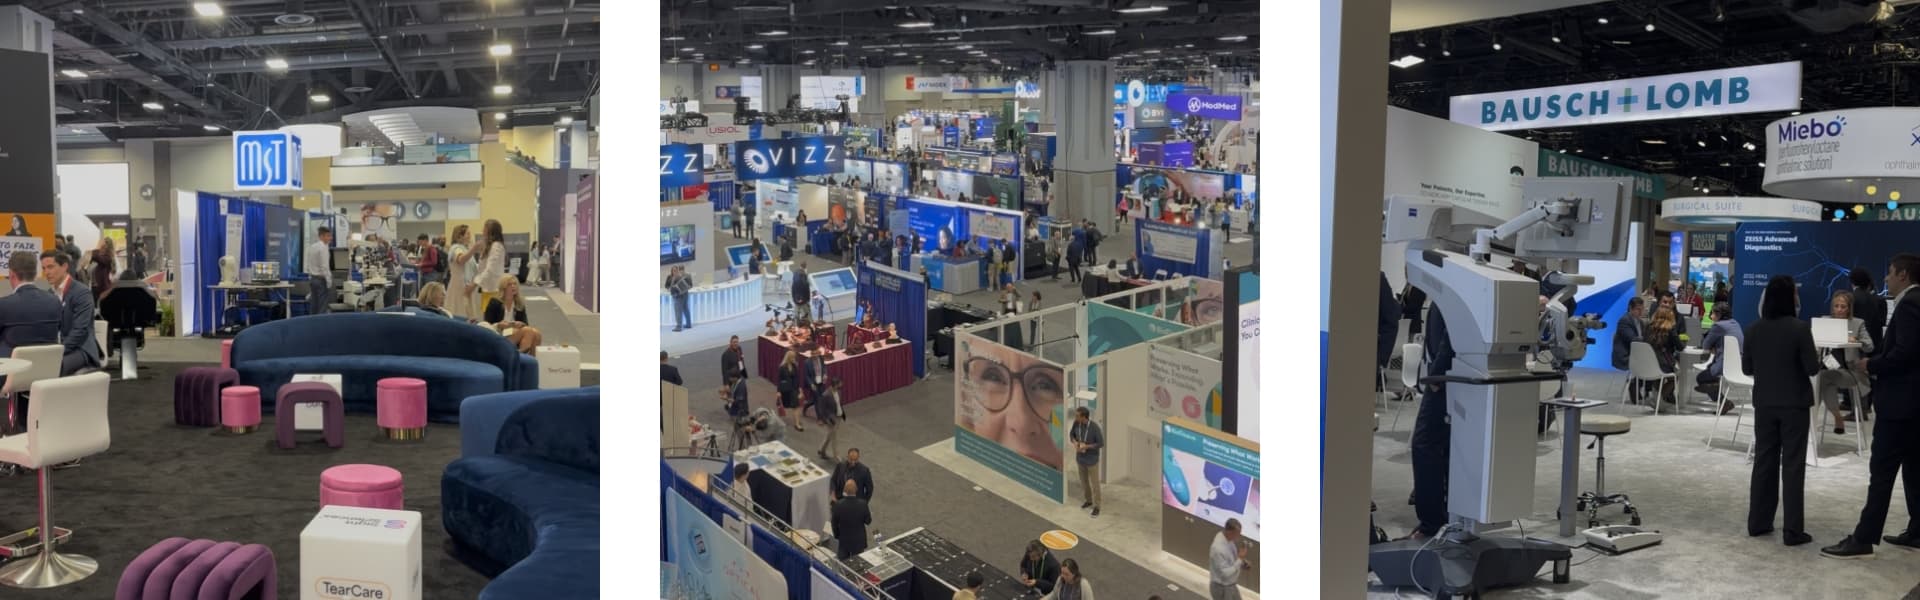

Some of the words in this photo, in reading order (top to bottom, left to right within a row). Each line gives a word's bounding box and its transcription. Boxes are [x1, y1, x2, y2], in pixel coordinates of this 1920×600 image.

[1201, 101, 1237, 111] ModMed
[1481, 90, 1610, 124] BAUSCH
[1617, 87, 1638, 112] +
[1646, 76, 1750, 112] LOMB
[1778, 117, 1843, 144] Miebo
[768, 145, 836, 166] VIZZ
[1673, 200, 1711, 211] SURGICAL
[1715, 201, 1743, 211] SUITE
[1879, 208, 1920, 220] BAU
[14, 241, 35, 250] FAIR
[1744, 244, 1782, 252] Diagnostics
[322, 581, 383, 599] TearCare
